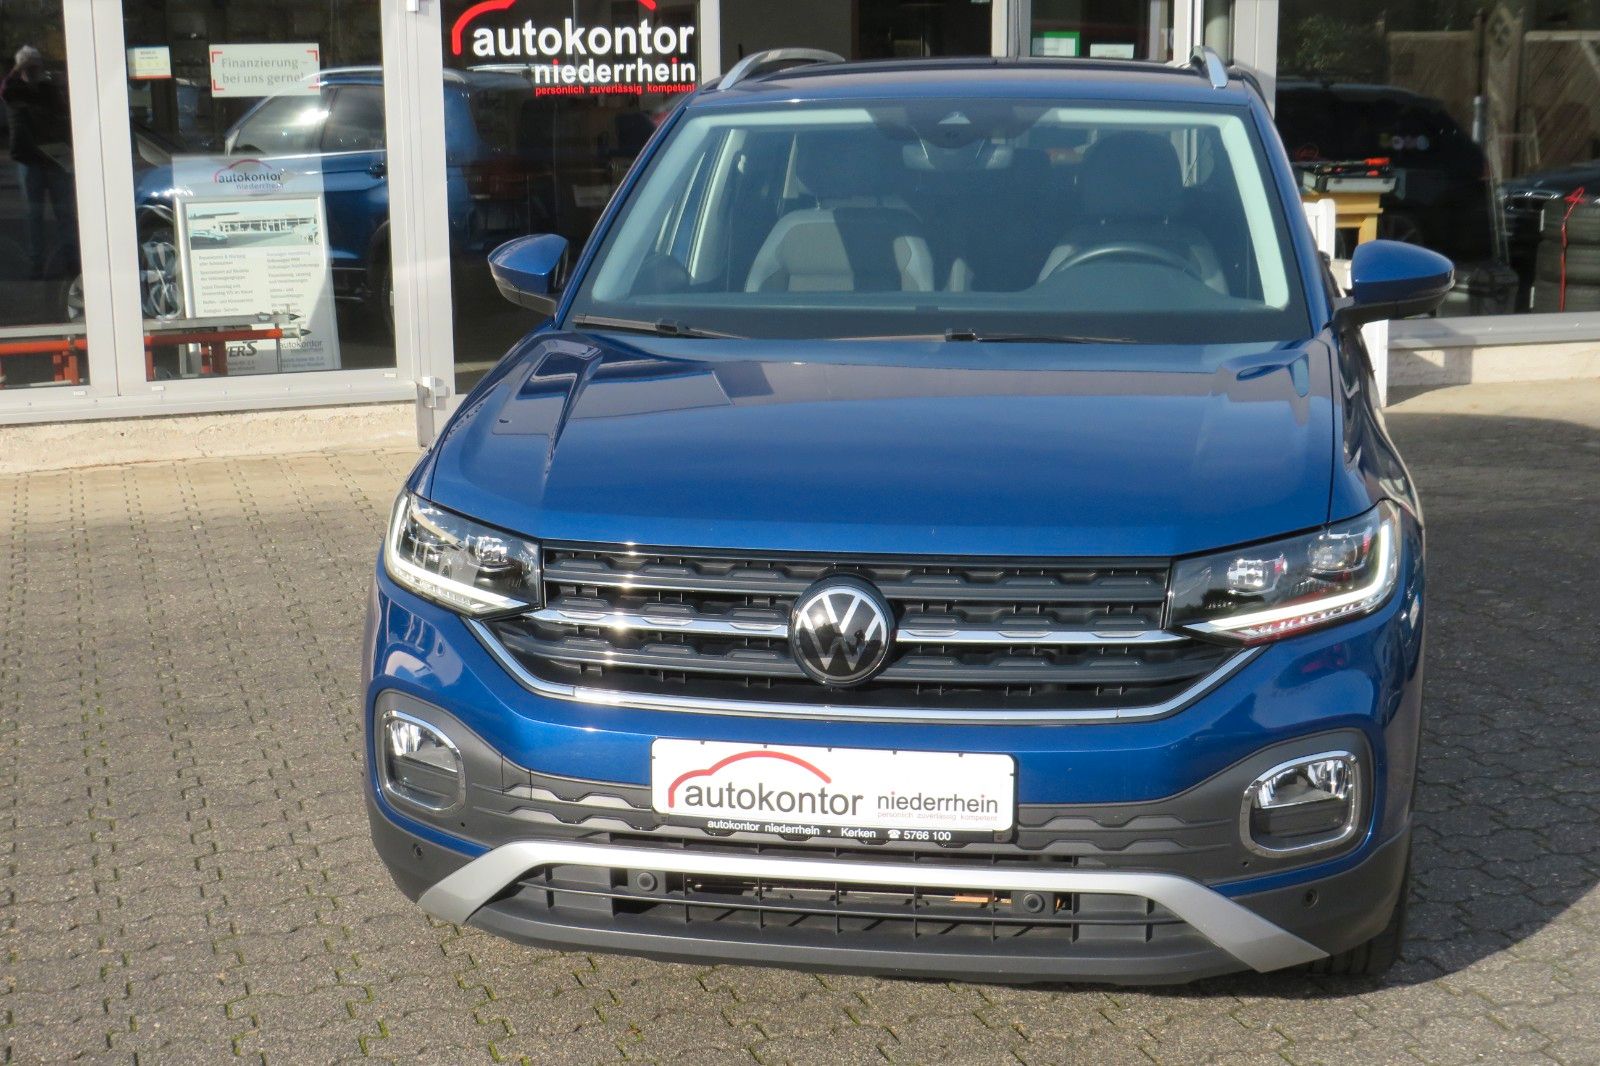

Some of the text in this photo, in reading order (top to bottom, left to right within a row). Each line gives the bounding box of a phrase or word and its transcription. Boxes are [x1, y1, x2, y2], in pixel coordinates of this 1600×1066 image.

[472, 18, 695, 56] autokontor
[221, 56, 299, 69] Finanzierung
[534, 57, 696, 83] niederrhein
[222, 73, 241, 84] bei
[243, 74, 262, 84] uns
[535, 82, 696, 96] persönlich zuverlässig kompetent
[218, 172, 282, 183] autokontor
[684, 782, 865, 816] autokontor
[877, 791, 998, 813] niederrhein
[707, 820, 952, 841] autokontor niederrhein Kerken 5766 100
